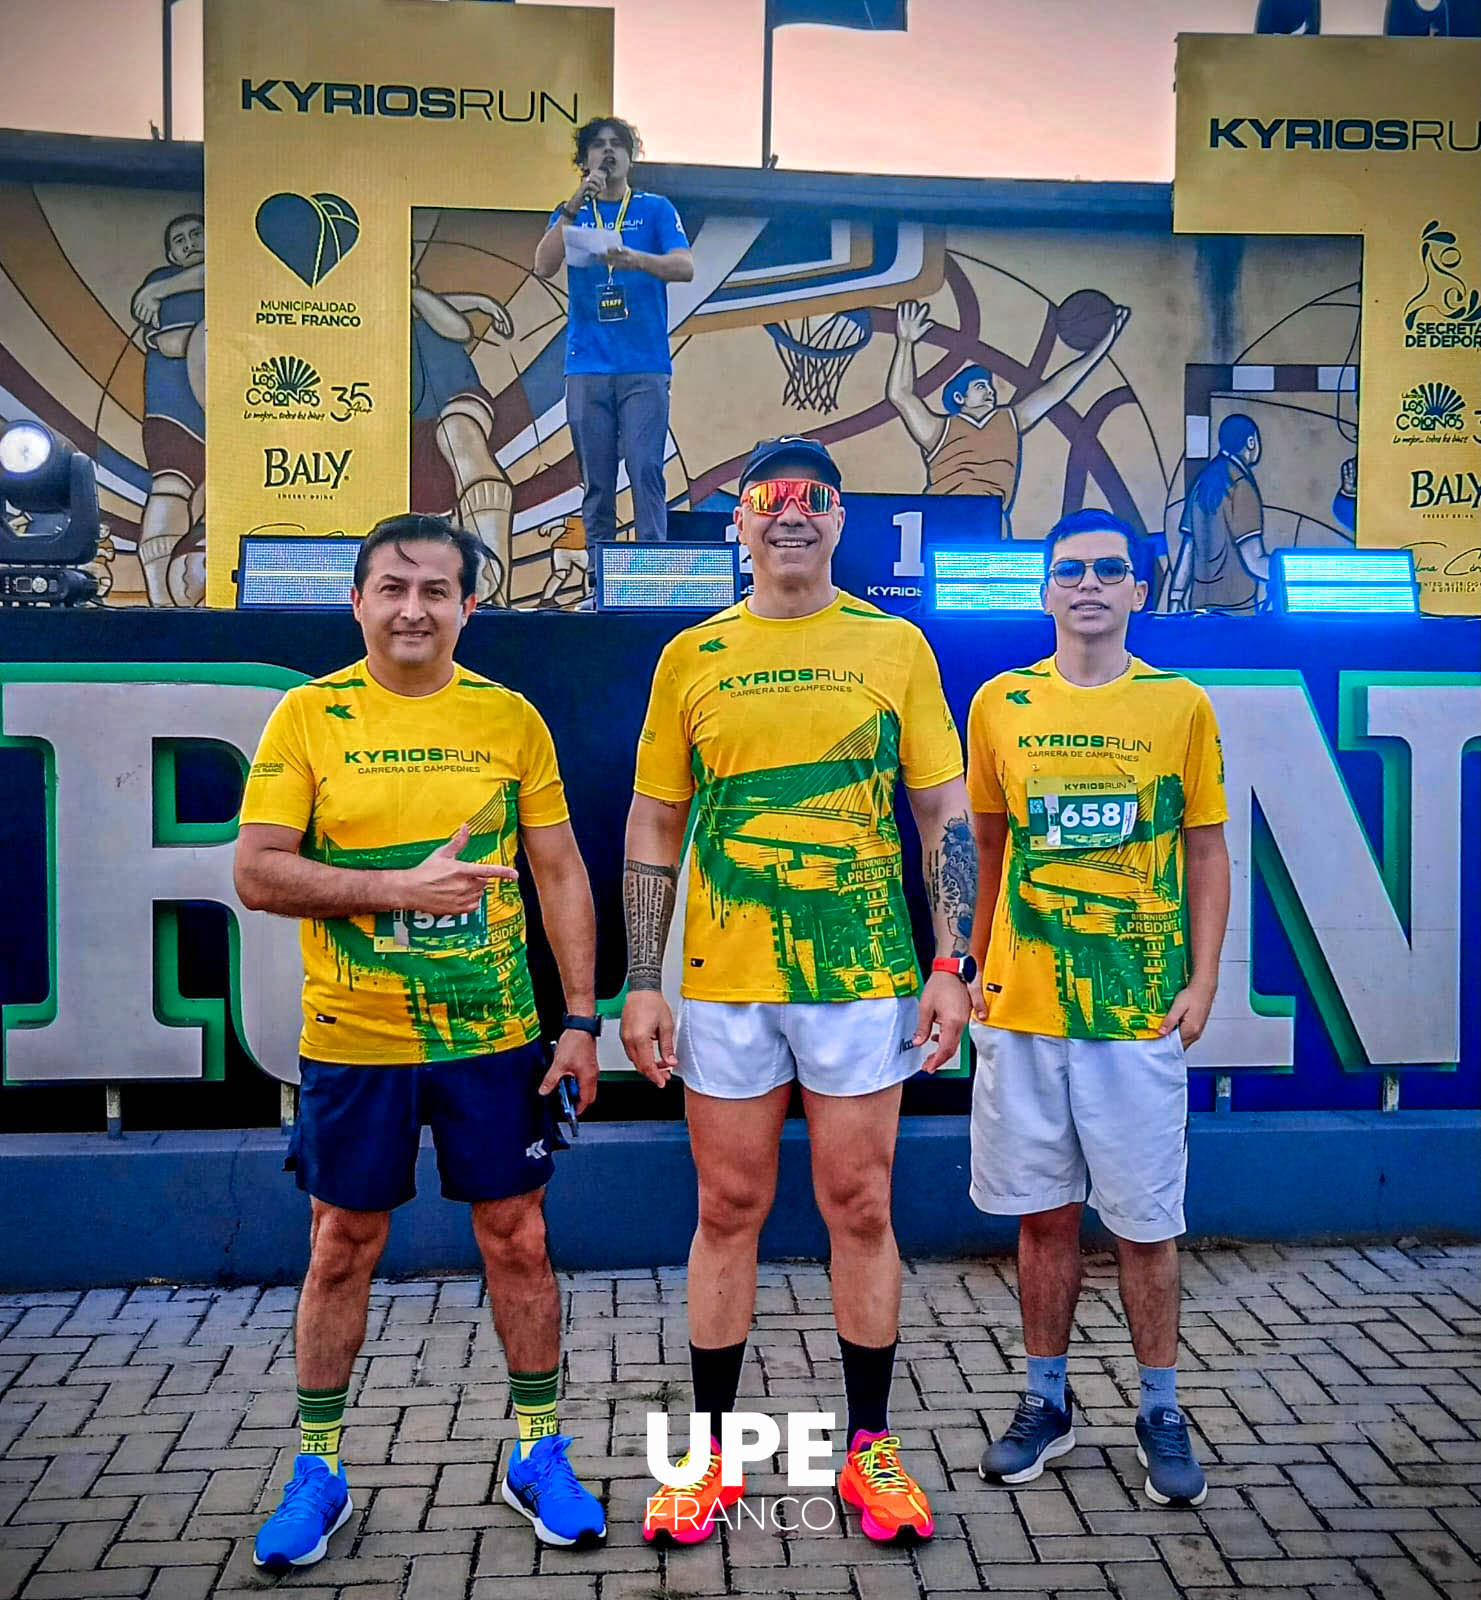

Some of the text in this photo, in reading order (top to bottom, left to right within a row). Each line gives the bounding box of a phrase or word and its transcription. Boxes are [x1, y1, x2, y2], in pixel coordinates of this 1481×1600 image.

[241, 78, 578, 124] KYRIOSRUN
[260, 300, 357, 313] MUNICIPALIDAD
[301, 314, 361, 327] FRANCO
[1405, 335, 1427, 348] DE
[252, 373, 277, 390] LOS
[330, 382, 373, 422] 35
[1403, 400, 1425, 415] LOS
[264, 448, 353, 490] BALY
[892, 511, 925, 577] 1
[719, 668, 864, 691] KYRIOSRUN
[730, 684, 853, 698] CARRERA DE CAMPEONES
[1017, 734, 1152, 752] KYRIOSRUN
[344, 748, 491, 764] KYRIOSRUN
[1027, 750, 1140, 762] CARRERA DE CAMPEONES
[358, 764, 481, 774] CARRERA DE CAMPEONES
[1064, 782, 1127, 791] KYRIOSRUN
[1060, 802, 1121, 828] 658
